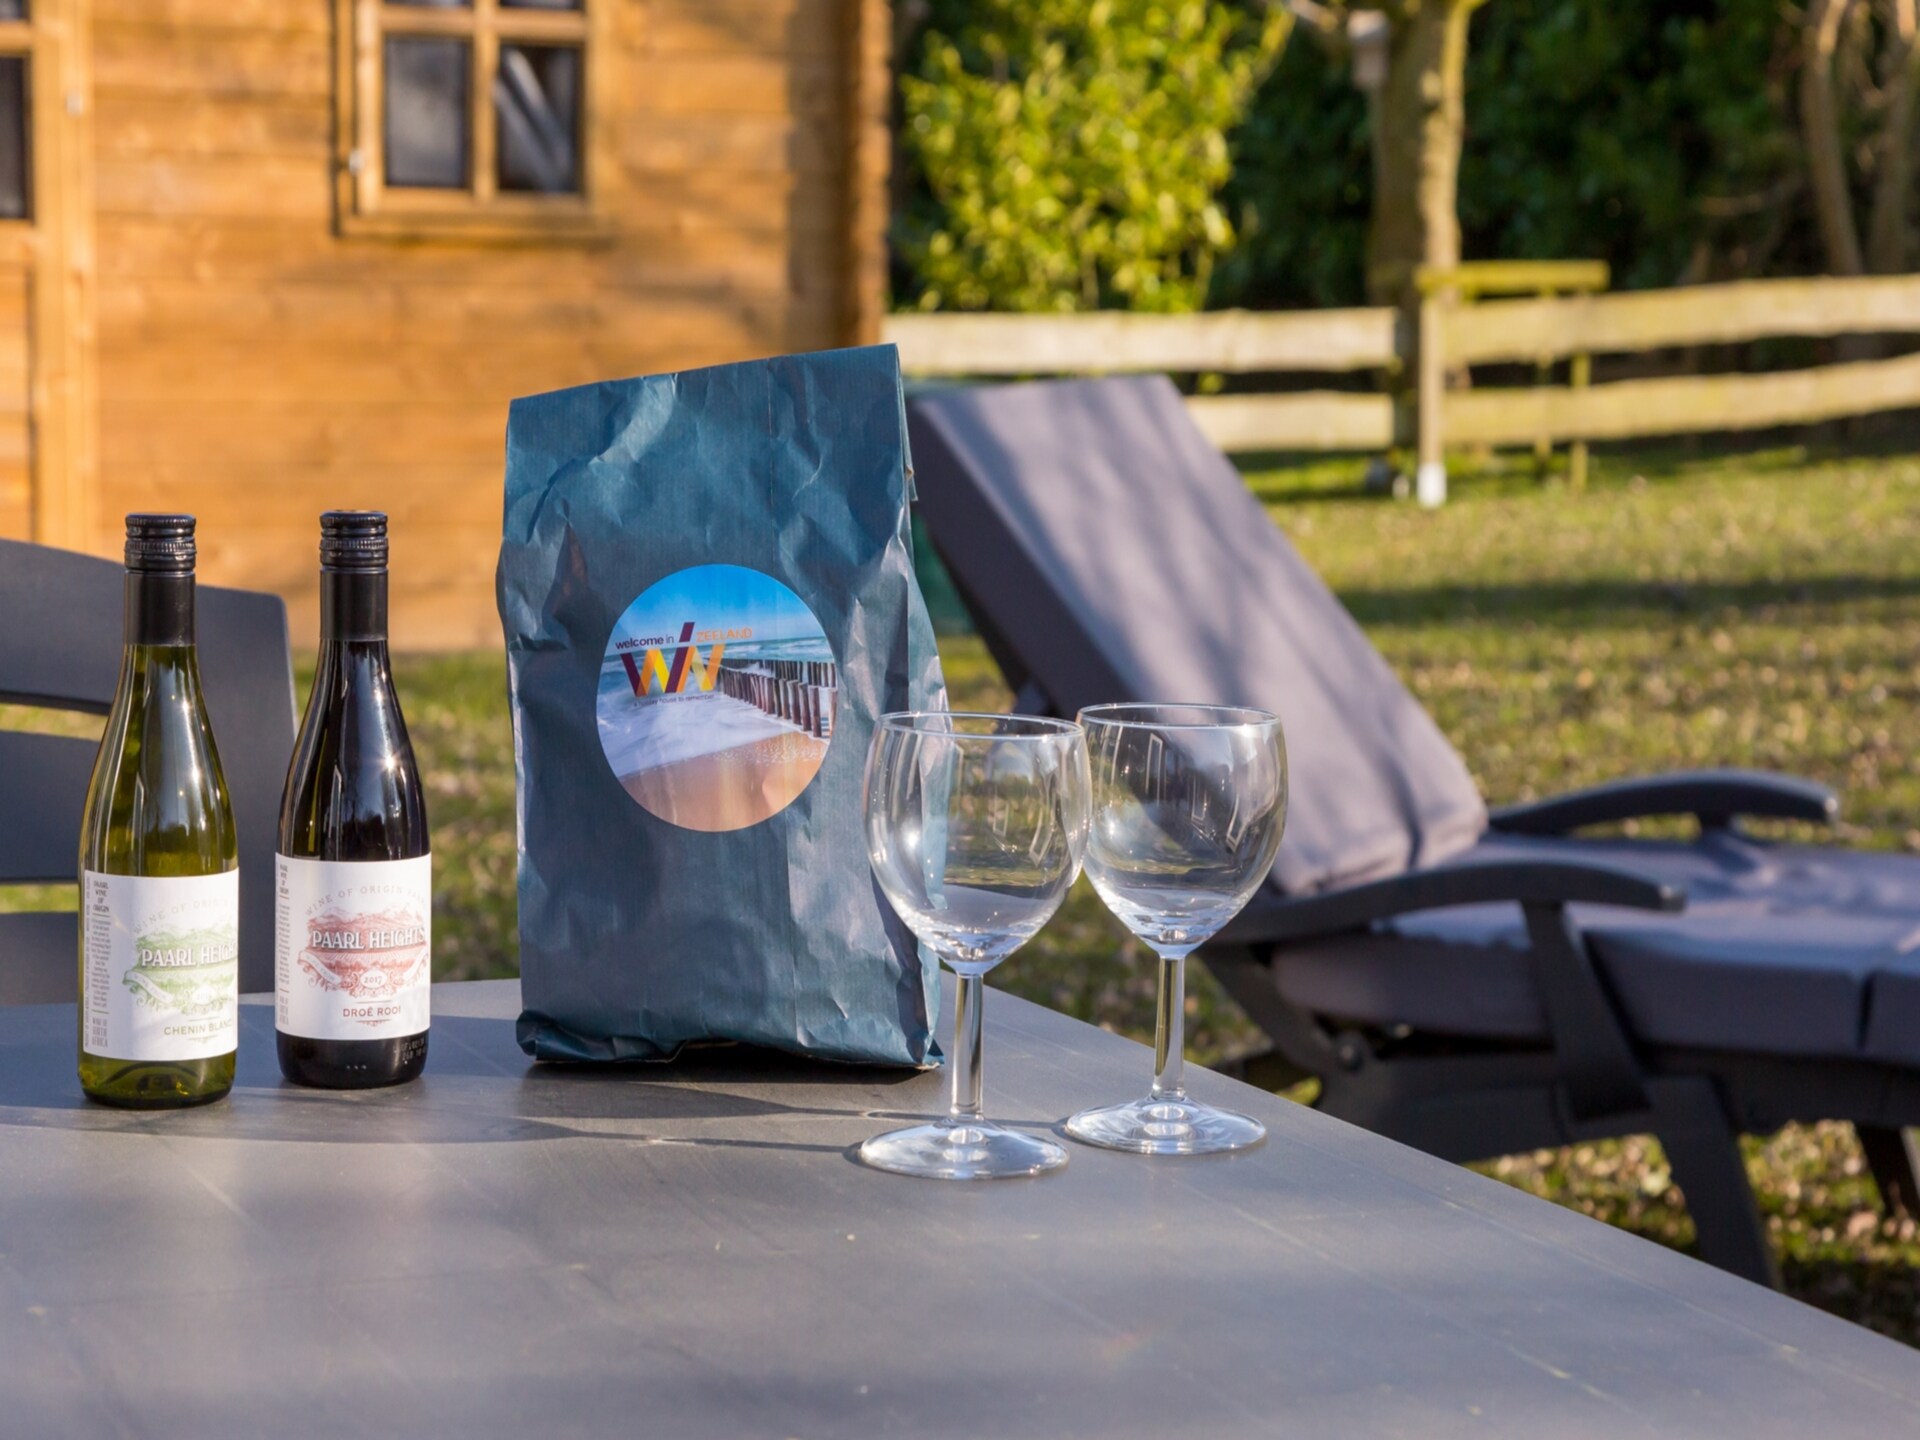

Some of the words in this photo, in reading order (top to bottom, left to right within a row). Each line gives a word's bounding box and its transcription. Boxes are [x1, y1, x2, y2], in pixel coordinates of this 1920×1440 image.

[615, 636, 664, 650] welcome
[666, 635, 674, 644] in
[696, 628, 753, 643] ZEELAND
[305, 894, 333, 916] WINE
[338, 888, 353, 898] OF
[360, 885, 403, 895] ORIGIN
[133, 911, 165, 934] WINE
[171, 903, 185, 914] OF
[312, 929, 364, 949] PAARL
[369, 927, 426, 948] HEIGHTS
[141, 949, 196, 967] PAARL
[364, 976, 382, 984] 2017
[163, 1024, 206, 1036] CHENIN
